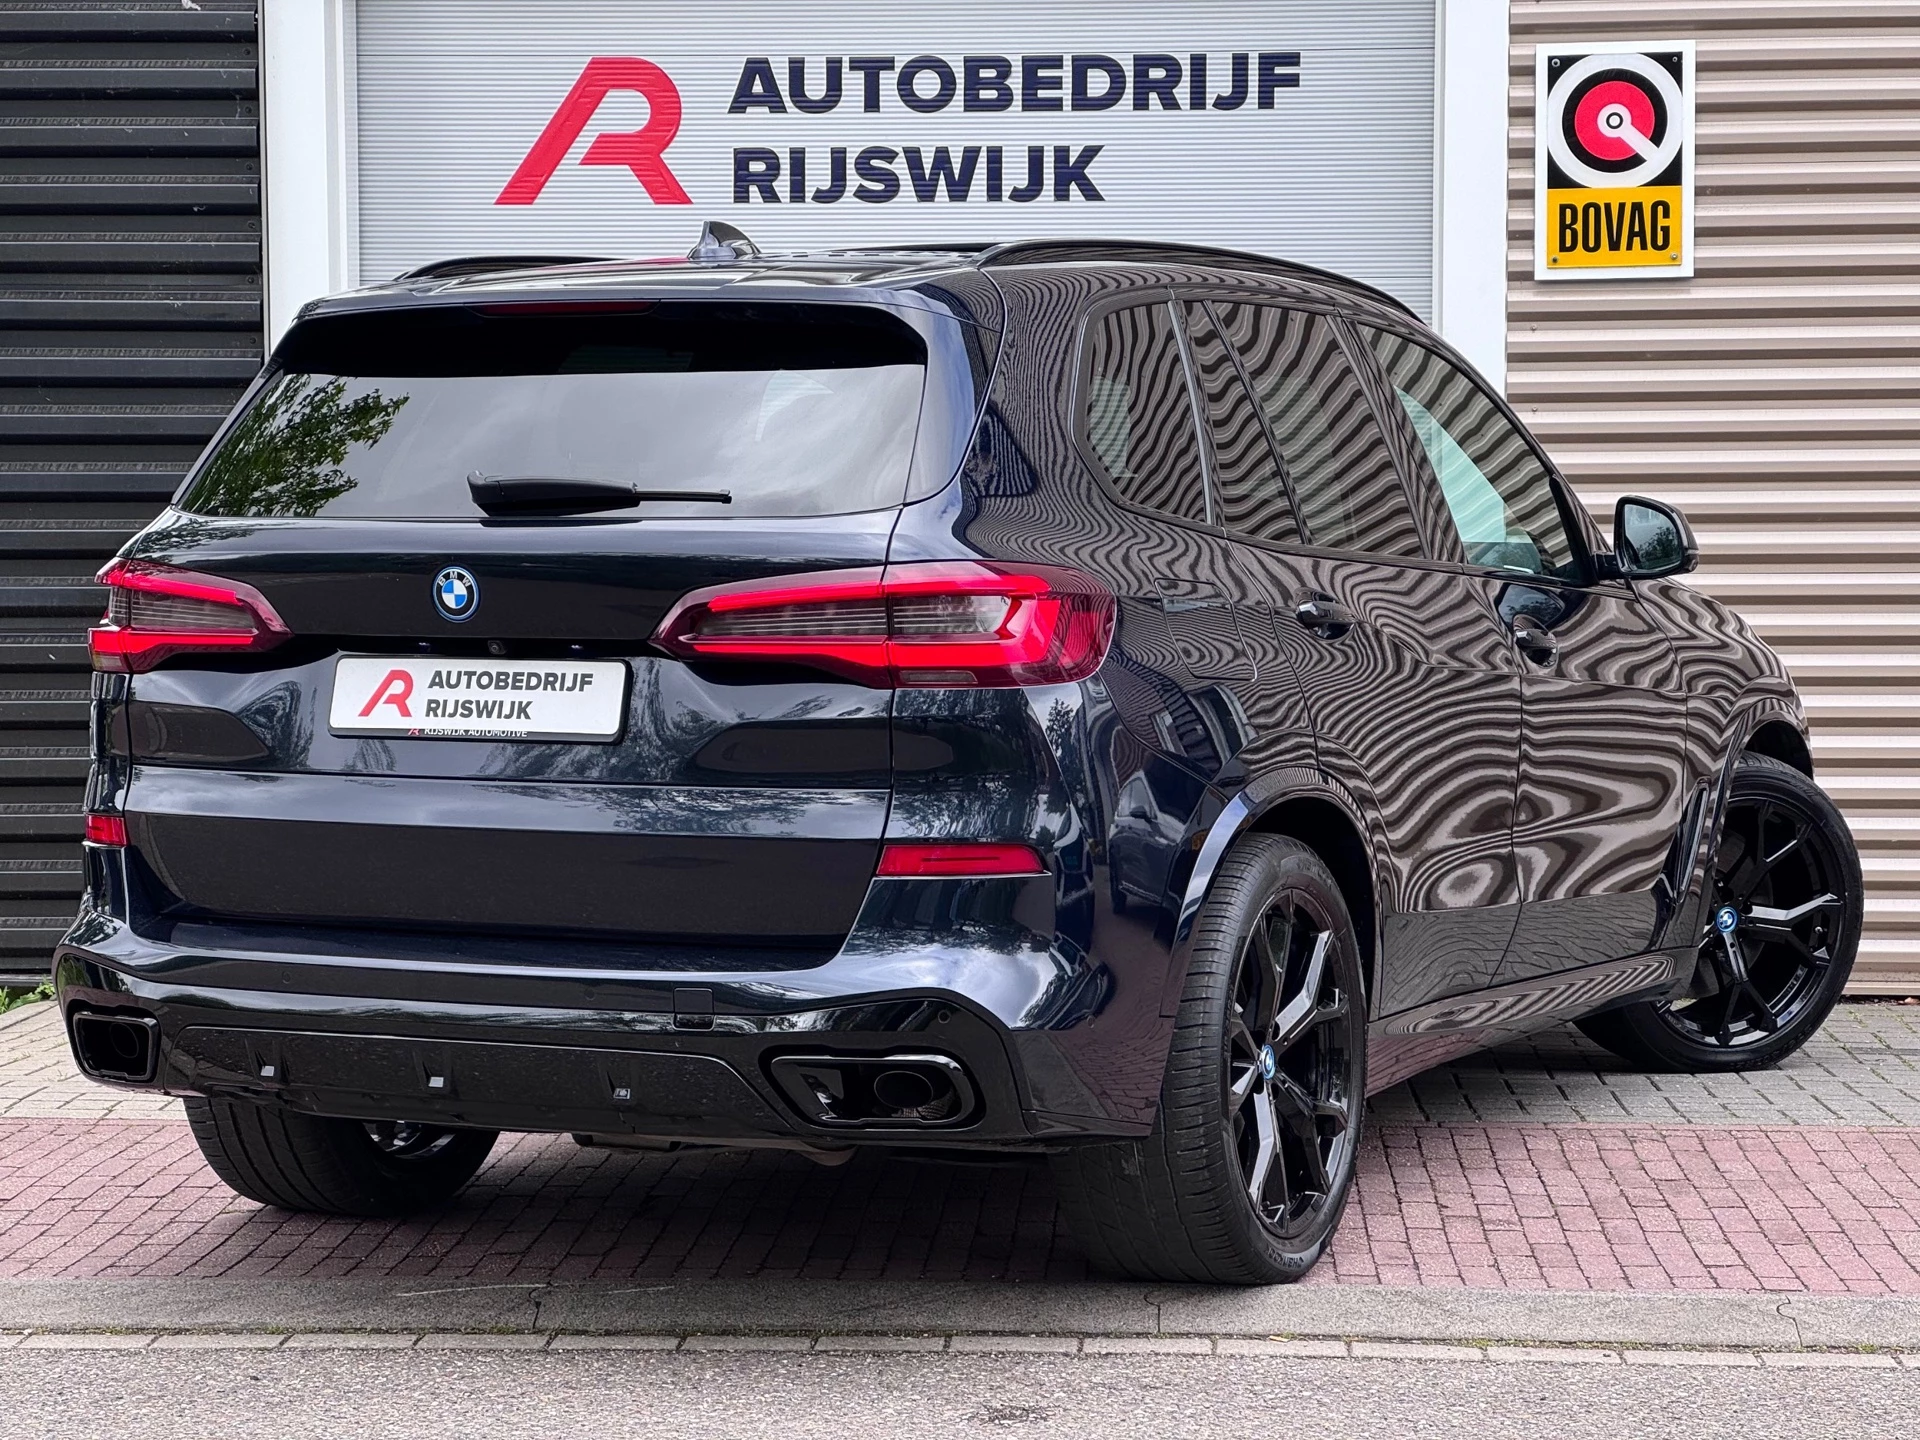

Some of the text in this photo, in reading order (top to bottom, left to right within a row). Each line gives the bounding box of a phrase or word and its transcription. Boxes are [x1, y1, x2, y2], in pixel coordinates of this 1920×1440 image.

[728, 51, 1302, 114] AUTOBEDRIJF
[733, 143, 1107, 204] RIJSWIJK
[1558, 200, 1670, 253] BOVAG
[438, 570, 472, 587] BMW
[428, 670, 594, 692] AUTOBEDRIJF
[425, 699, 533, 720] RIJSWIJK
[468, 729, 528, 738] AUTOMOTIVE
